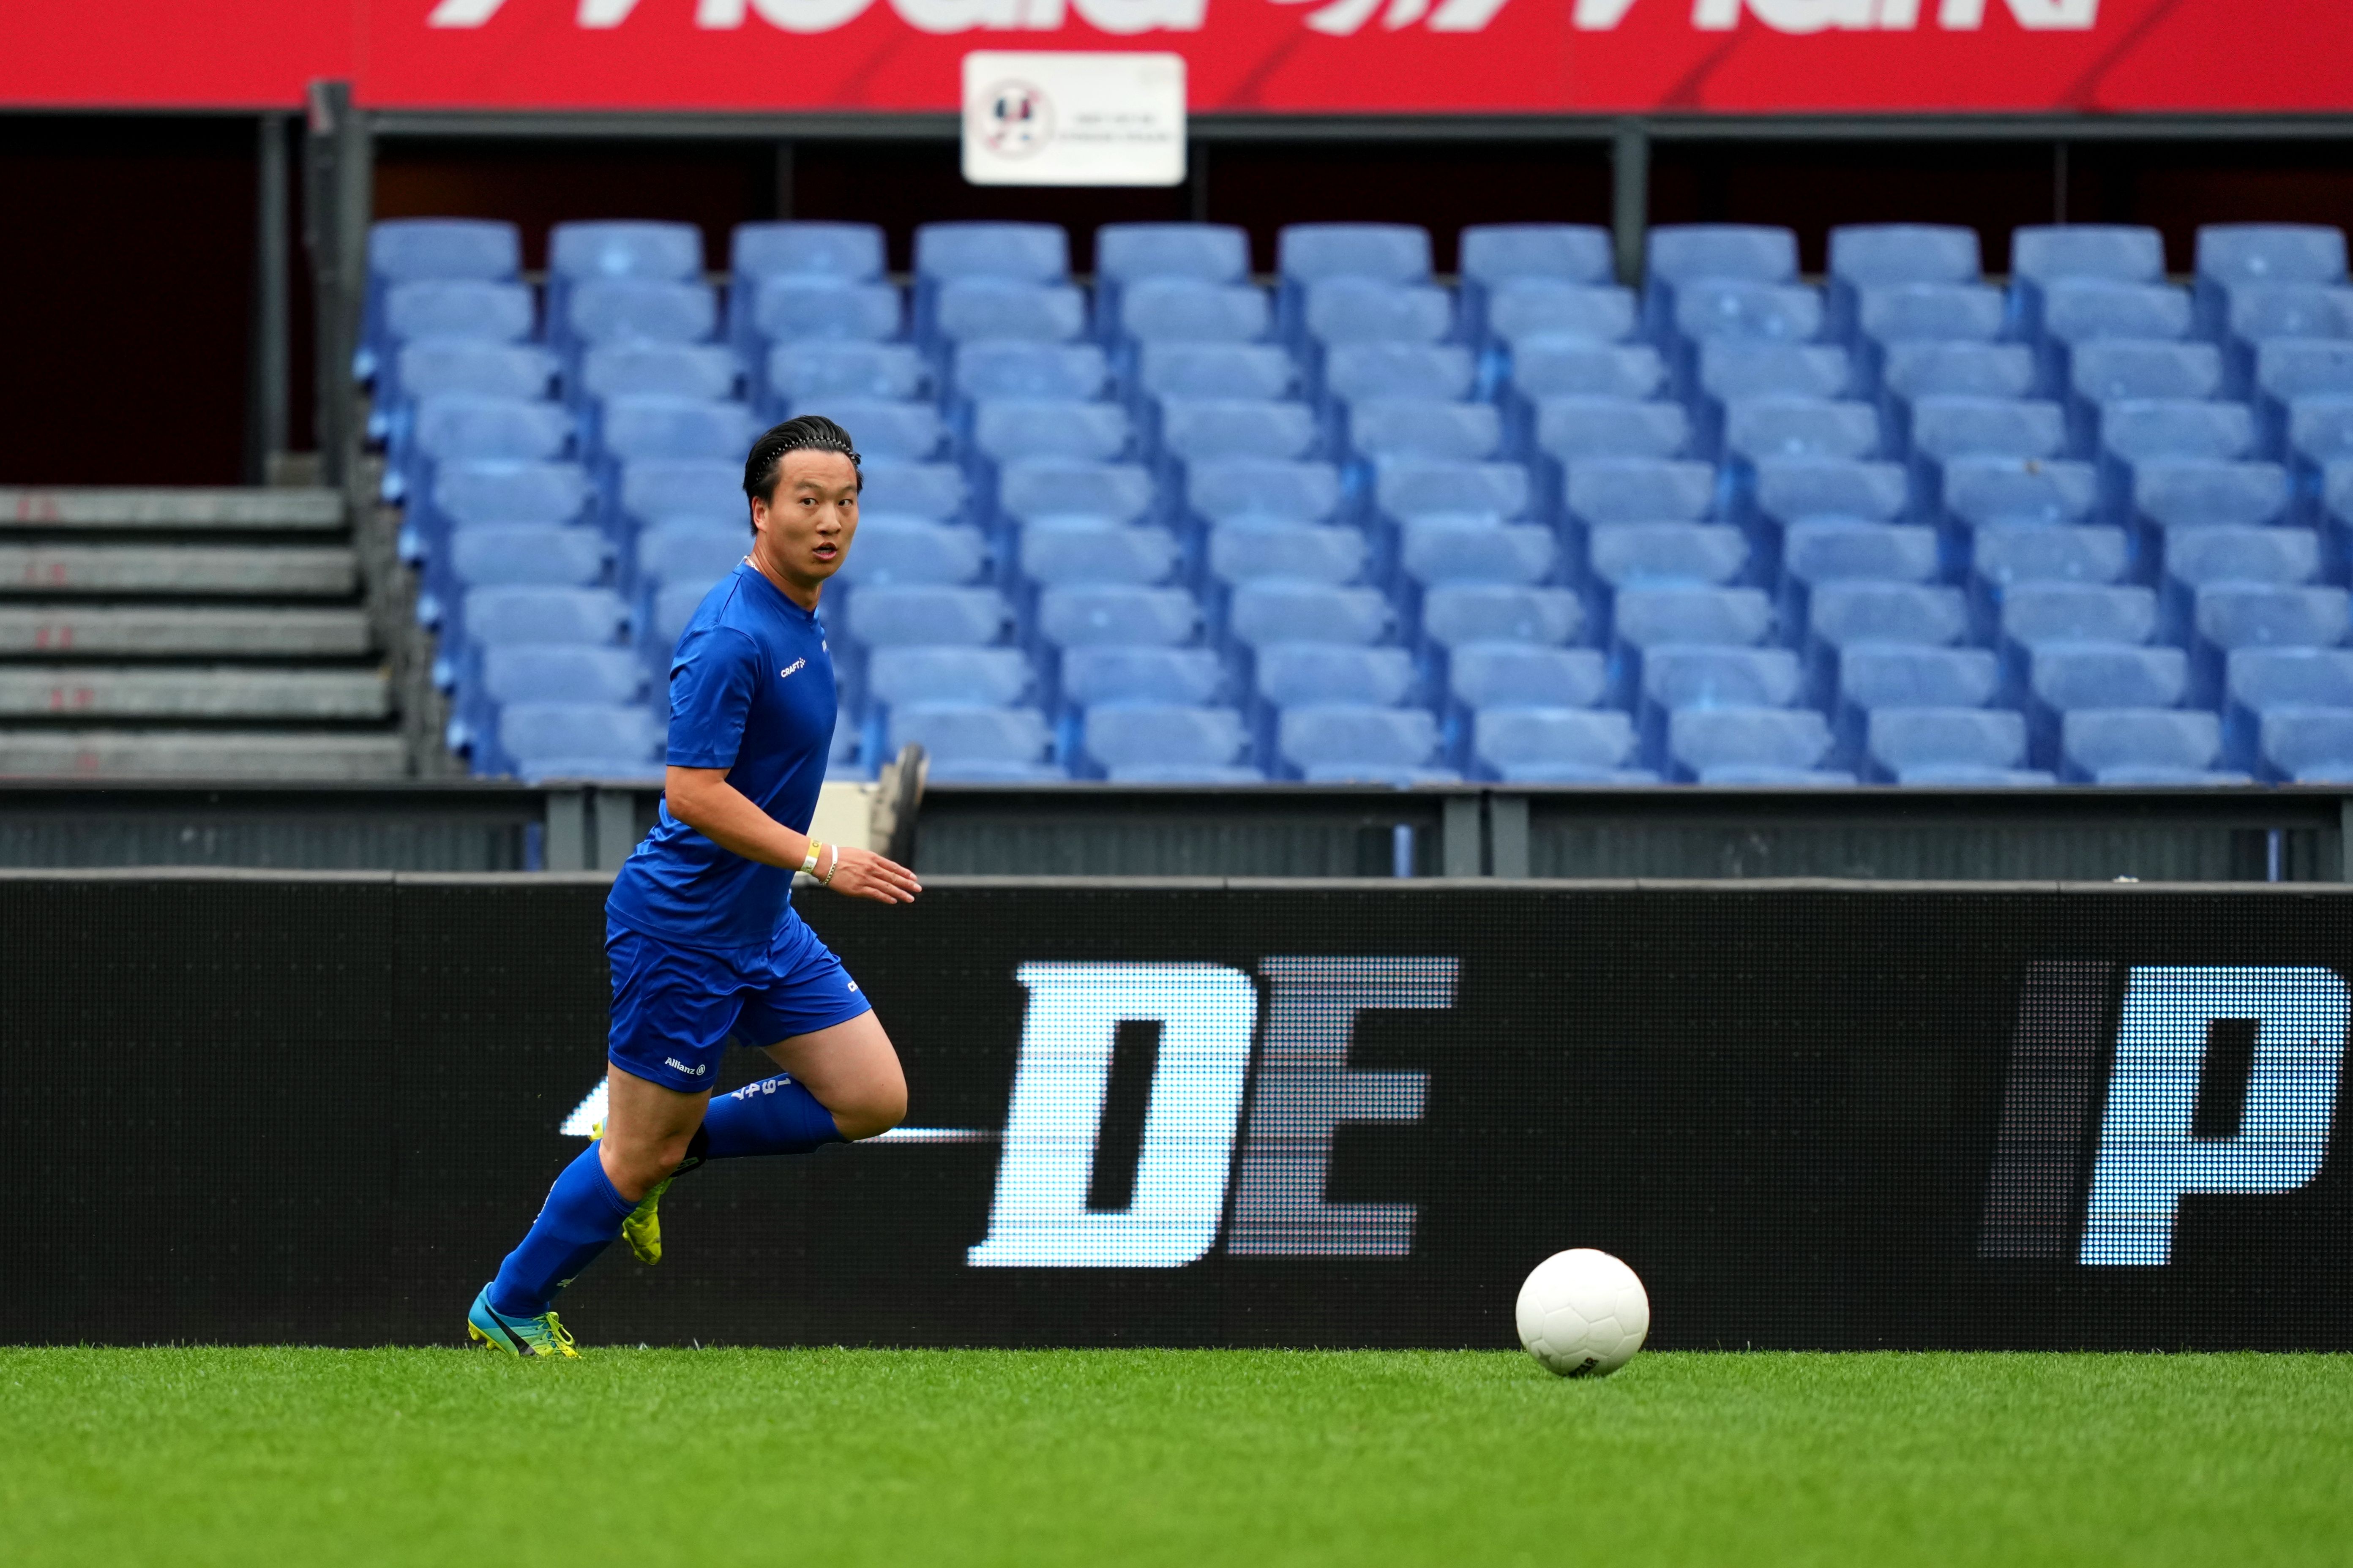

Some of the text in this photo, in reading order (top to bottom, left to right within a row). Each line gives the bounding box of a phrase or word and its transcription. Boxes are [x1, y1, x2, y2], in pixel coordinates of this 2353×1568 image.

[781, 660, 800, 678] CRAFT
[664, 1057, 696, 1074] Allianz
[731, 1078, 791, 1100] 1947
